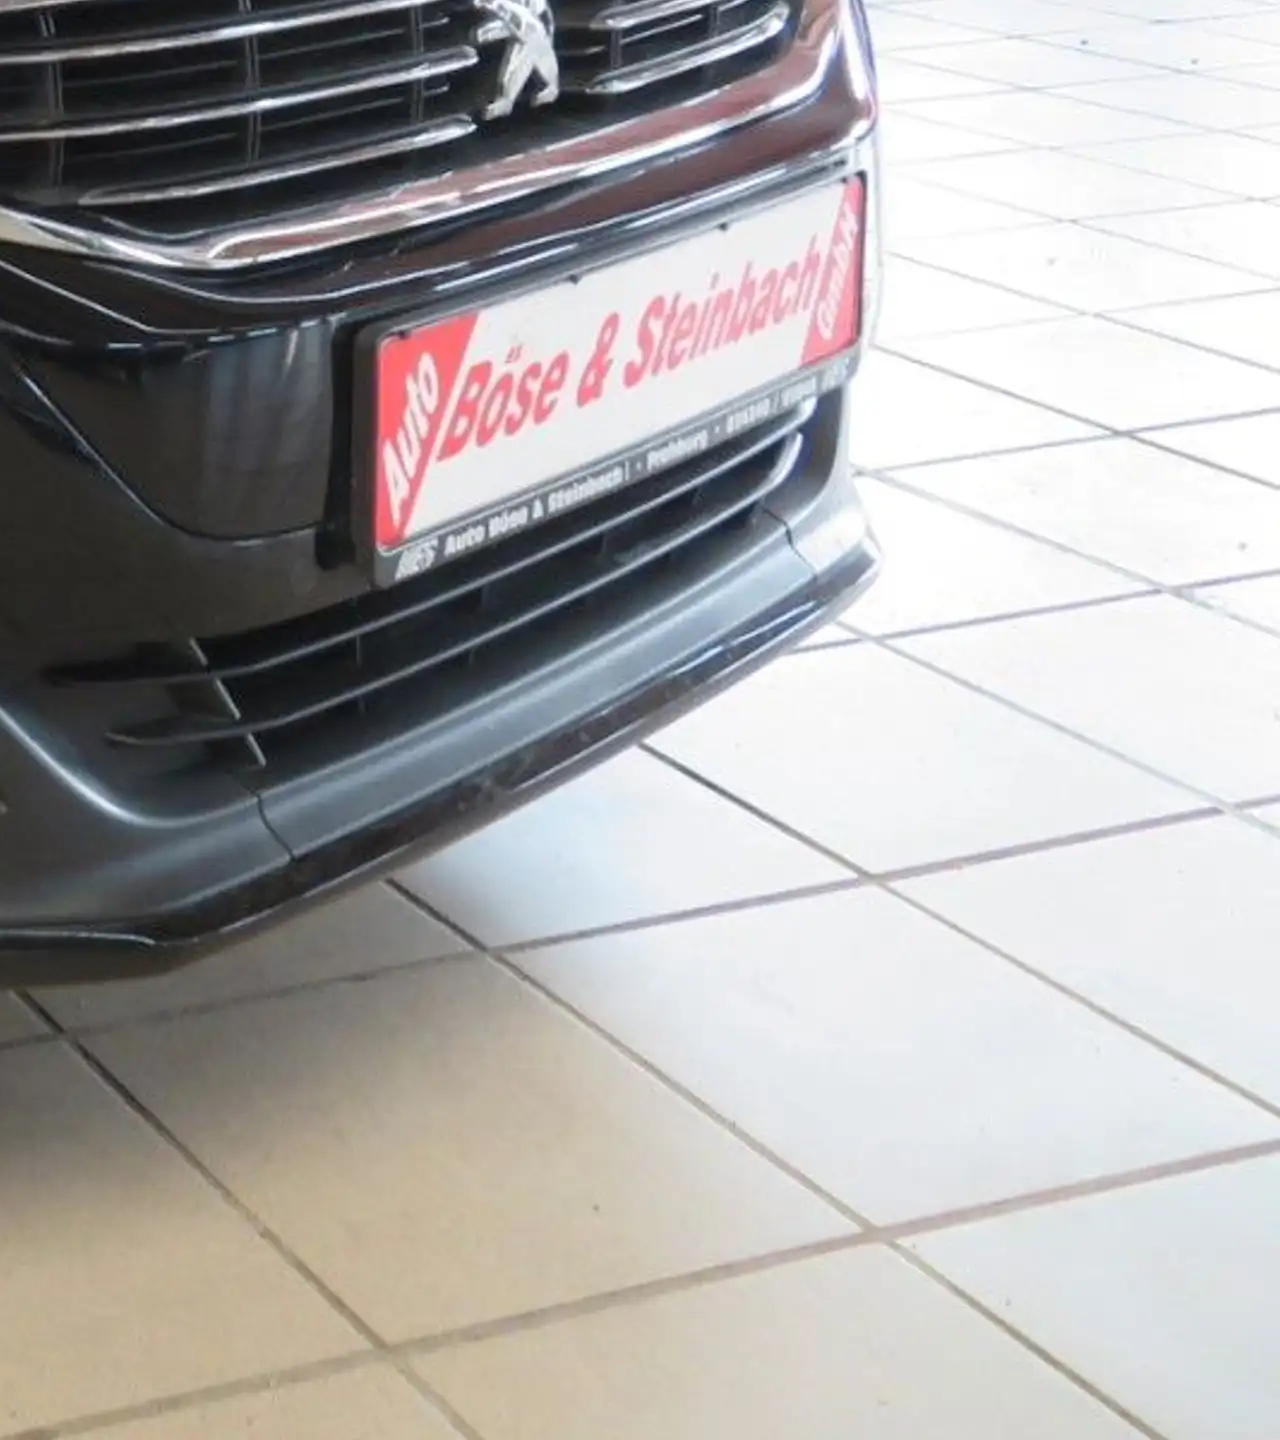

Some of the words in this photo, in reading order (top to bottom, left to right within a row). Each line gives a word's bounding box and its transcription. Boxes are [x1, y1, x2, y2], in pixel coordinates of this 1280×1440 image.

[436, 344, 571, 462] Böse
[576, 312, 619, 407] &
[624, 235, 821, 388] Steinbach
[382, 351, 439, 529] Auto
[444, 524, 486, 557] Auto
